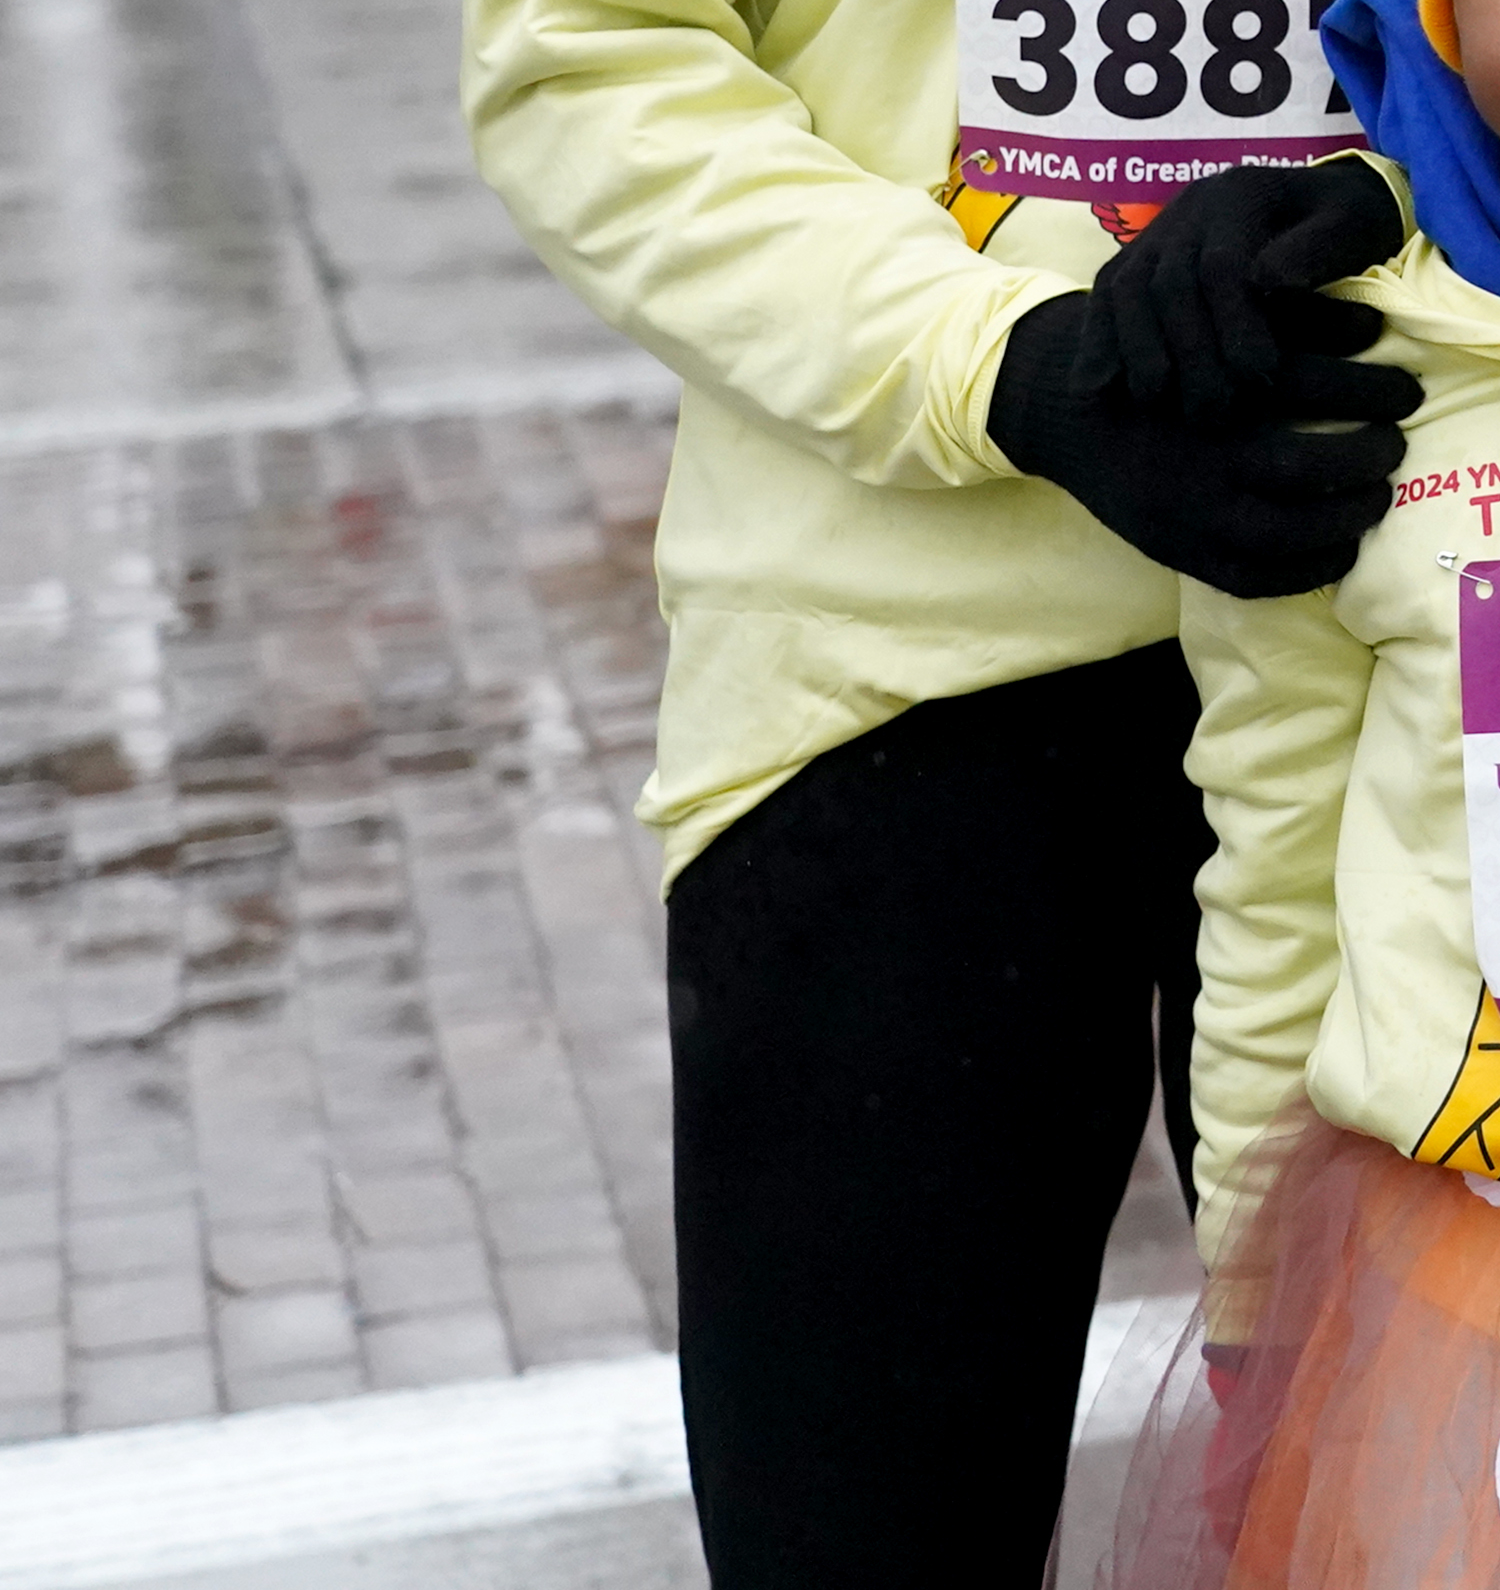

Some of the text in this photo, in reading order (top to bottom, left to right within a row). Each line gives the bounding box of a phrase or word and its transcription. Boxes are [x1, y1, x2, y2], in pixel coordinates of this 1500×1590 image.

[1000, 146, 1081, 182] YMCA
[1089, 155, 1116, 183] of
[1395, 470, 1460, 508] 2024
